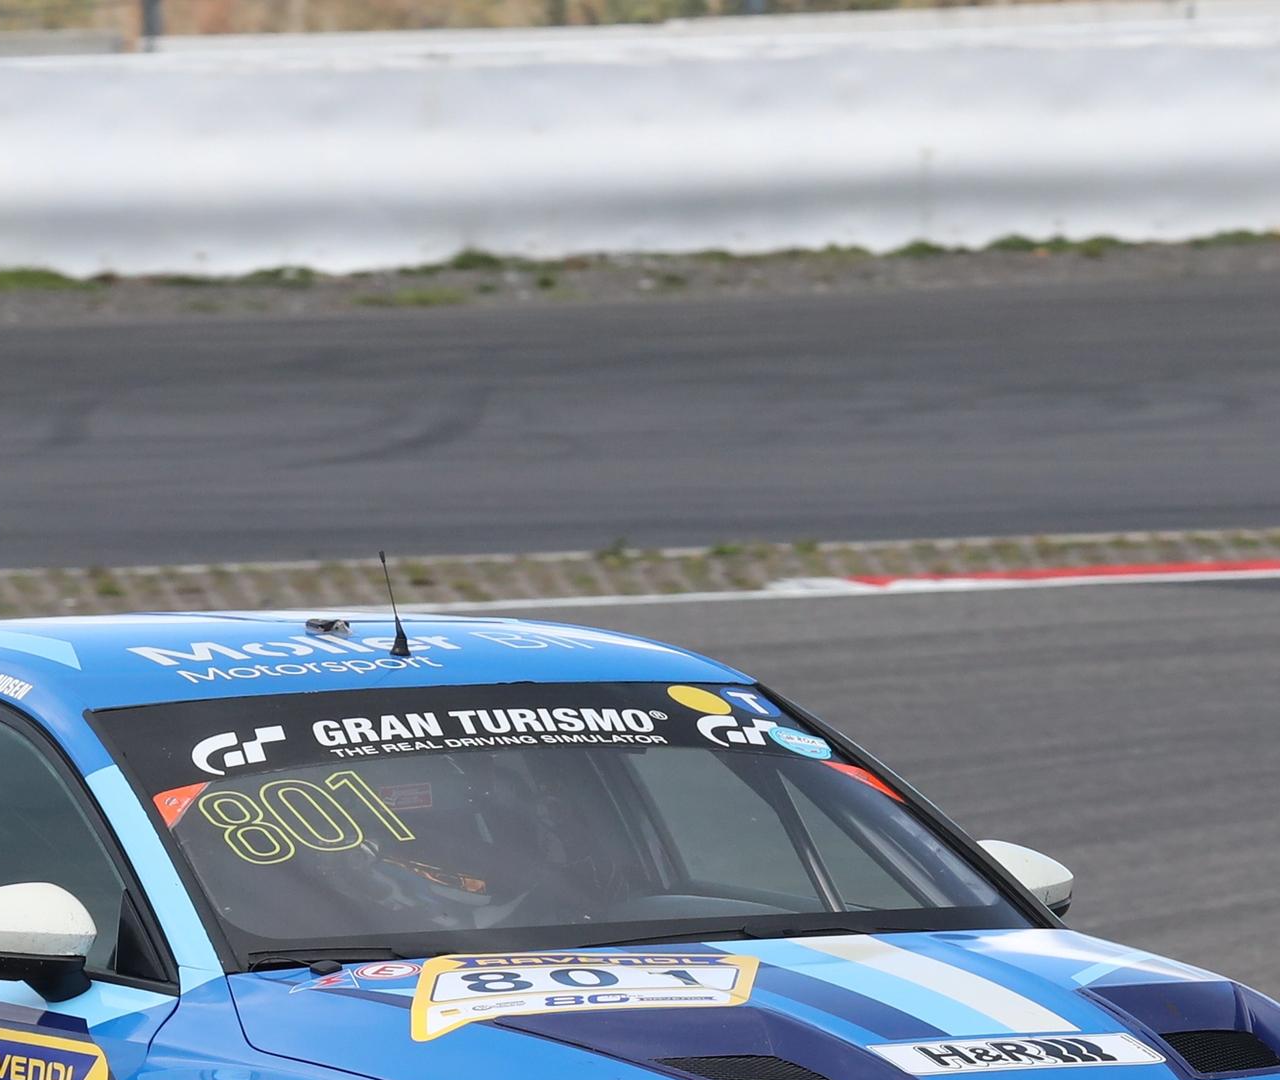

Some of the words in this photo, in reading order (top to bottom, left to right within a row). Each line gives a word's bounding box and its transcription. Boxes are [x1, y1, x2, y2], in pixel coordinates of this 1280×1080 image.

[176, 652, 443, 684] Motorsport
[727, 691, 769, 714] T
[312, 711, 444, 747] GRAN
[330, 744, 380, 758] THE
[381, 740, 443, 754] REAL
[444, 735, 538, 749] DRIVING
[539, 733, 669, 745] SIMULATOR
[198, 770, 416, 865] 801
[371, 964, 401, 978] E
[913, 1039, 1045, 1070] H&R
